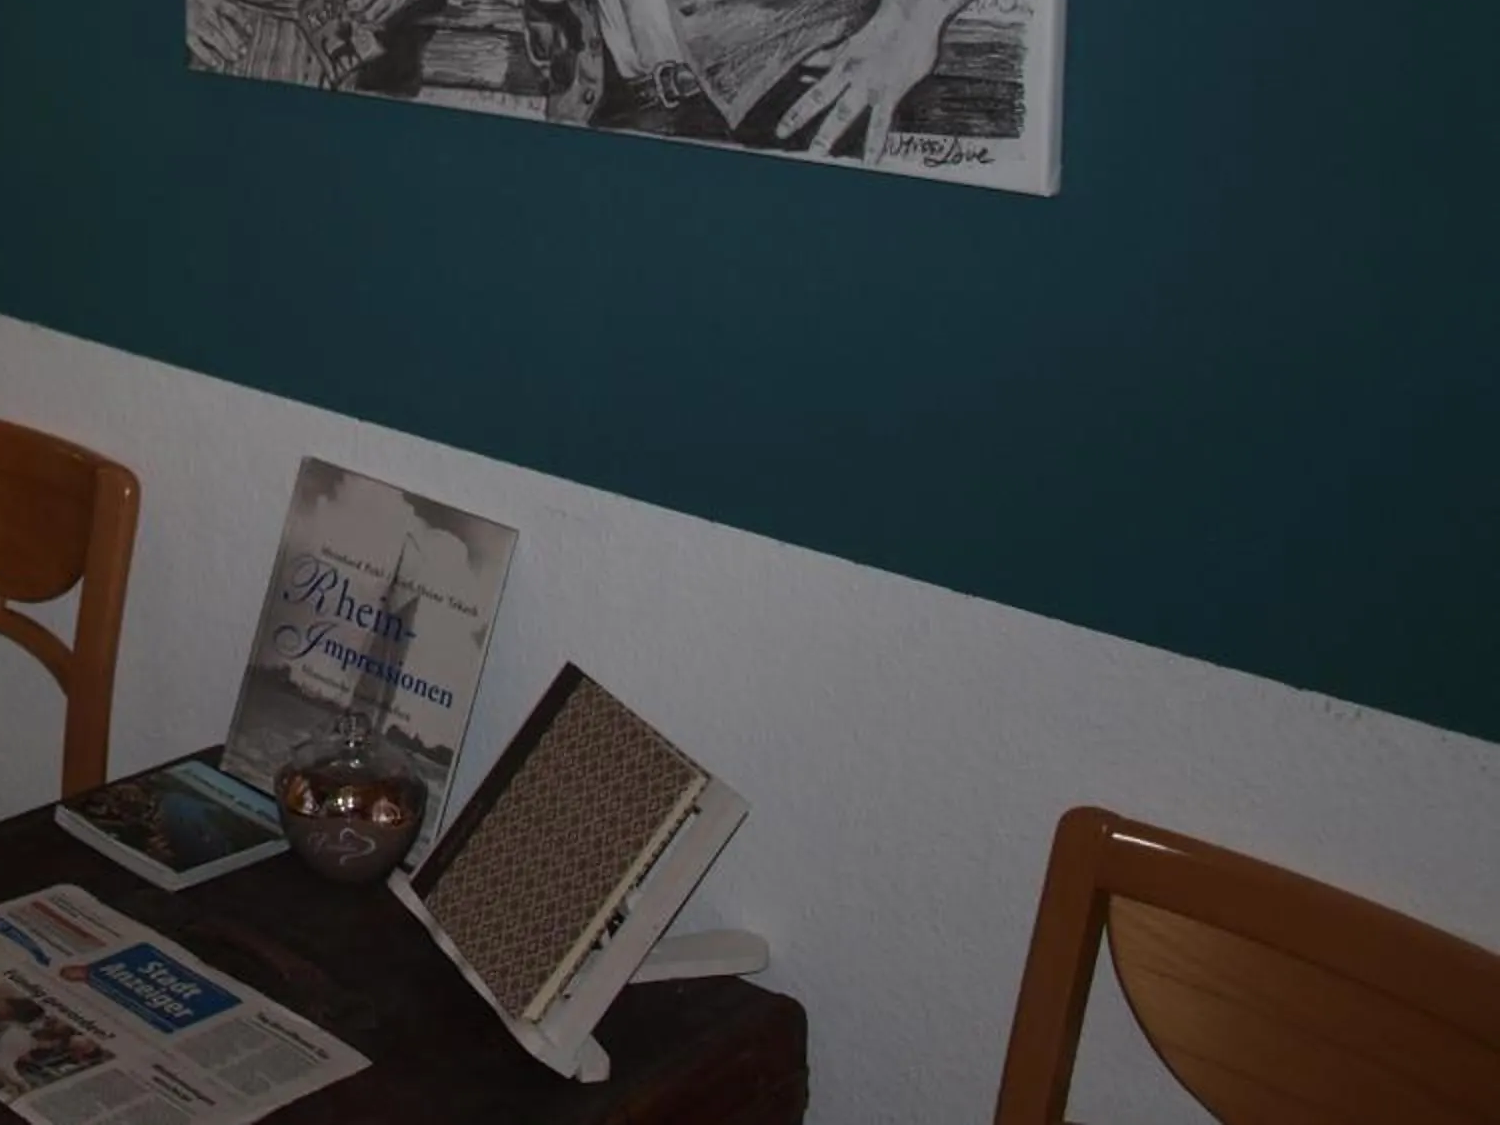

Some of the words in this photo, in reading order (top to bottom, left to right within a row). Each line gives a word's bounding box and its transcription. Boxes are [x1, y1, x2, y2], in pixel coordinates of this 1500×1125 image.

[282, 554, 417, 642] Rhein-
[273, 621, 454, 709] Impressionen
[99, 962, 194, 1018] Anzeiger
[137, 961, 202, 999] Stadt
